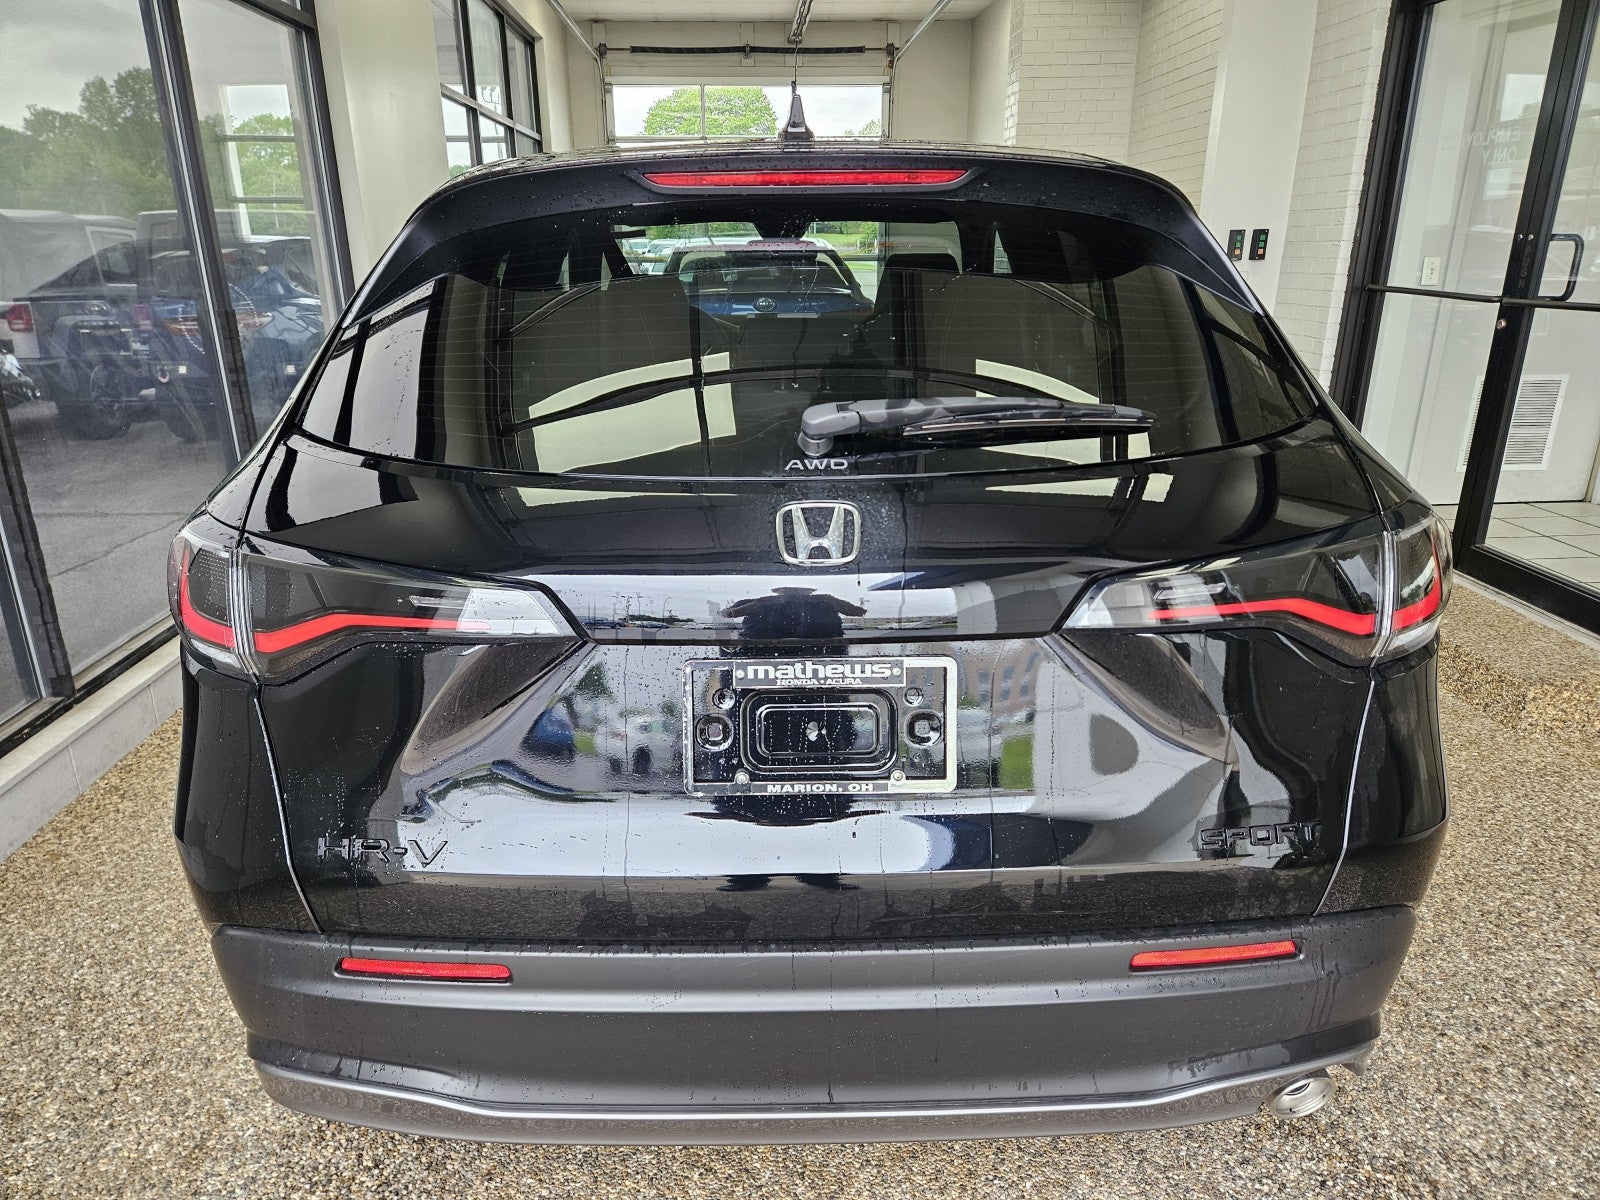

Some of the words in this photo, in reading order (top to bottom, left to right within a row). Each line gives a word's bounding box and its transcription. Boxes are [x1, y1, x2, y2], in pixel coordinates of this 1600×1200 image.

[1517, 245, 1532, 288] PUSH
[784, 459, 849, 471] AWD
[747, 661, 892, 679] mathews
[776, 678, 820, 686] HONDA
[766, 784, 843, 793] MARION,
[847, 783, 874, 792] OH
[1200, 819, 1322, 850] SPORT
[317, 837, 449, 865] HR-V
